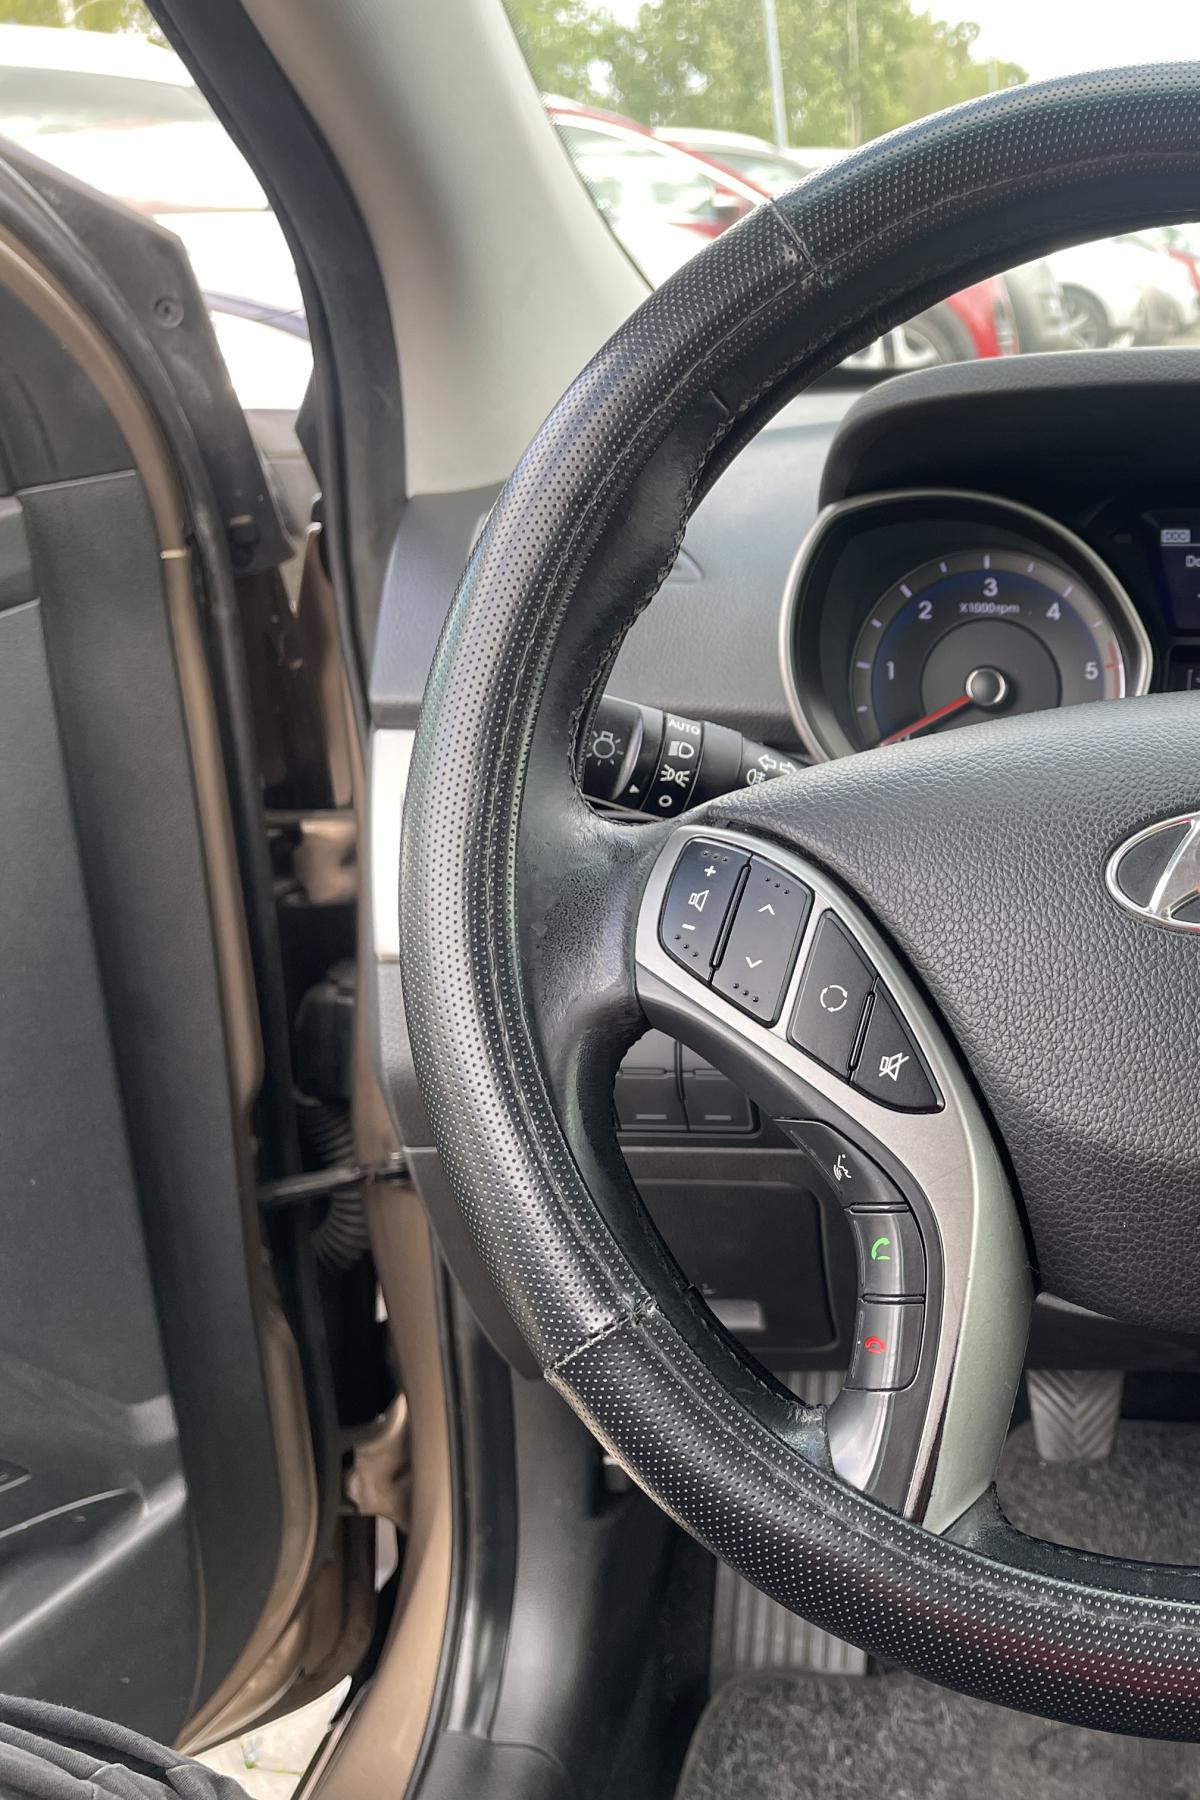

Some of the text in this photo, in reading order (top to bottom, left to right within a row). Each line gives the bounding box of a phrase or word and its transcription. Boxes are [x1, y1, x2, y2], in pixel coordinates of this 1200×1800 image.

[983, 577, 998, 597] 3
[918, 600, 933, 620] 2
[1046, 602, 1061, 620] 4
[886, 661, 895, 680] 1
[1085, 661, 1099, 680] 5
[668, 719, 701, 736] AUTO
